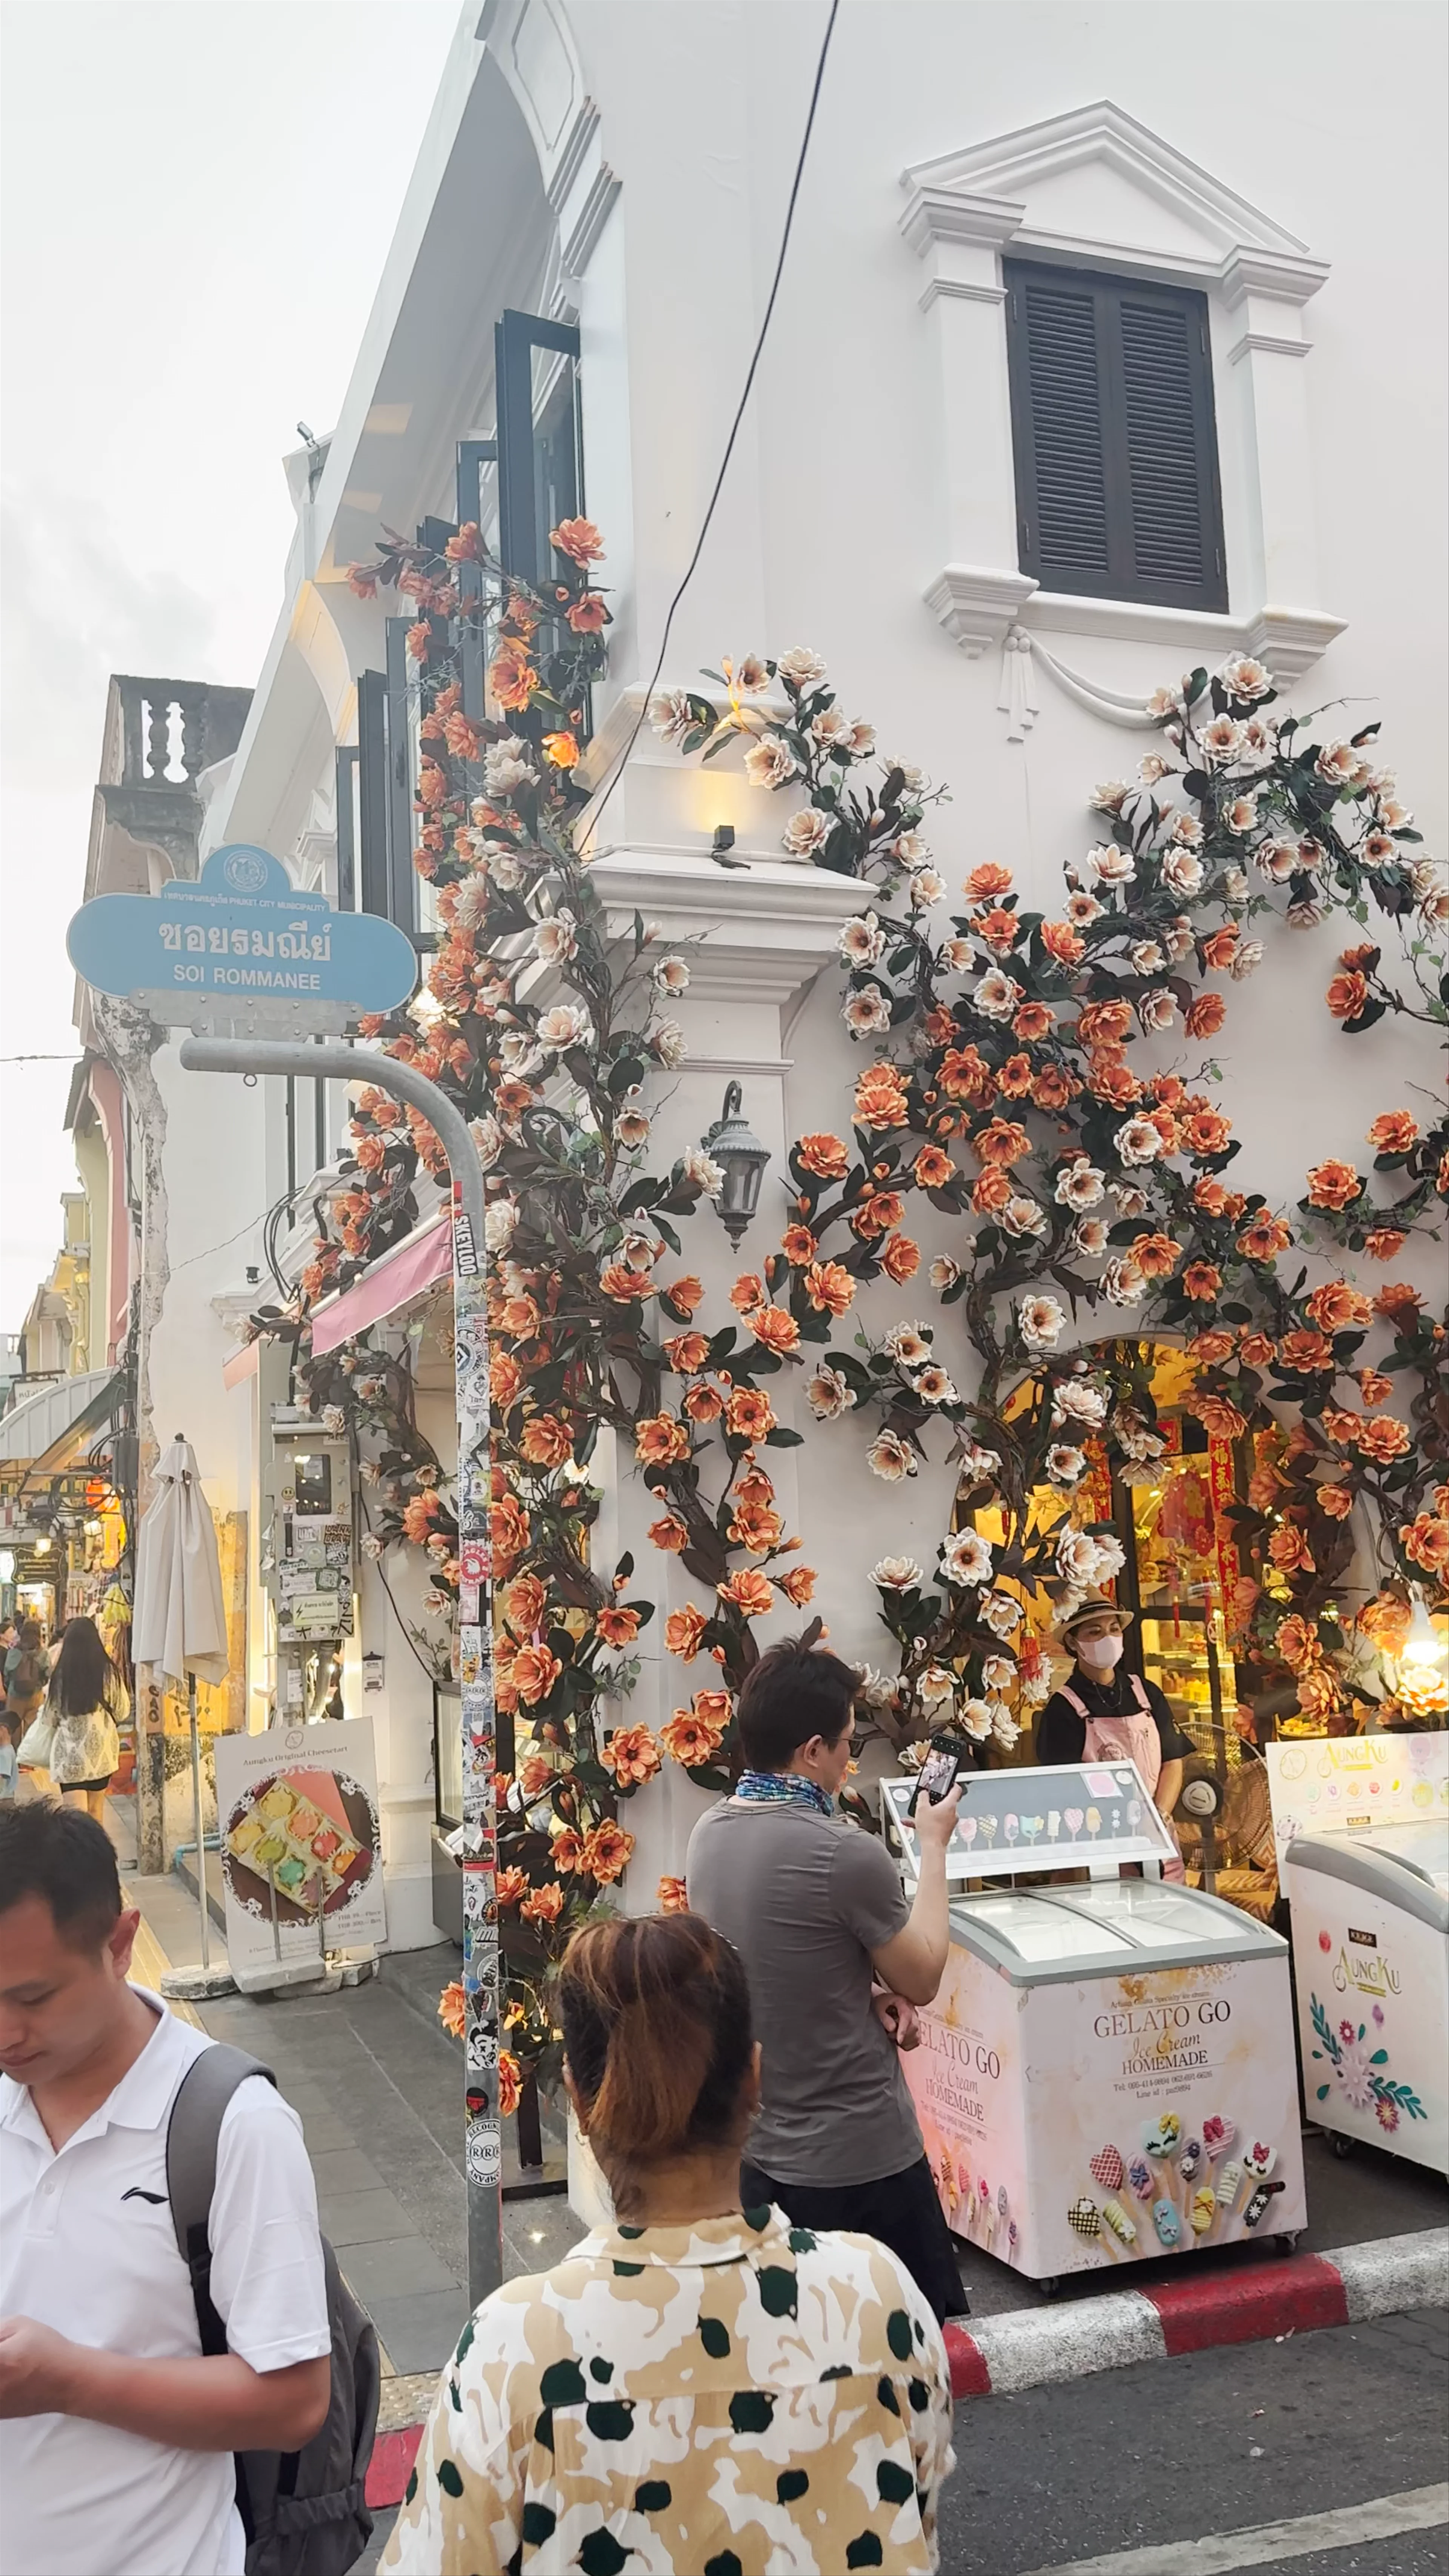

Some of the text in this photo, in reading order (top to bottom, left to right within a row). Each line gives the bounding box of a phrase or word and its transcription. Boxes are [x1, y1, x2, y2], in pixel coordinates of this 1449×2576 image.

[229, 897, 257, 906] PHUKET
[277, 901, 325, 912] MUNICIPALITY
[158, 920, 332, 961] ซอยรมณีย์
[174, 964, 321, 990] SOI ROMMANEE
[275, 1751, 306, 1761] Original
[307, 1746, 348, 1756] Cheesetart
[1094, 2000, 1231, 2038] GELATO GO
[918, 2020, 970, 2066] ELATO
[976, 2046, 1000, 2079] GO
[1132, 2030, 1200, 2059] Ice Cream
[948, 2060, 978, 2094] Cream
[1122, 2050, 1208, 2075] HOMEMADE
[925, 2078, 984, 2122] HOMEMADE
